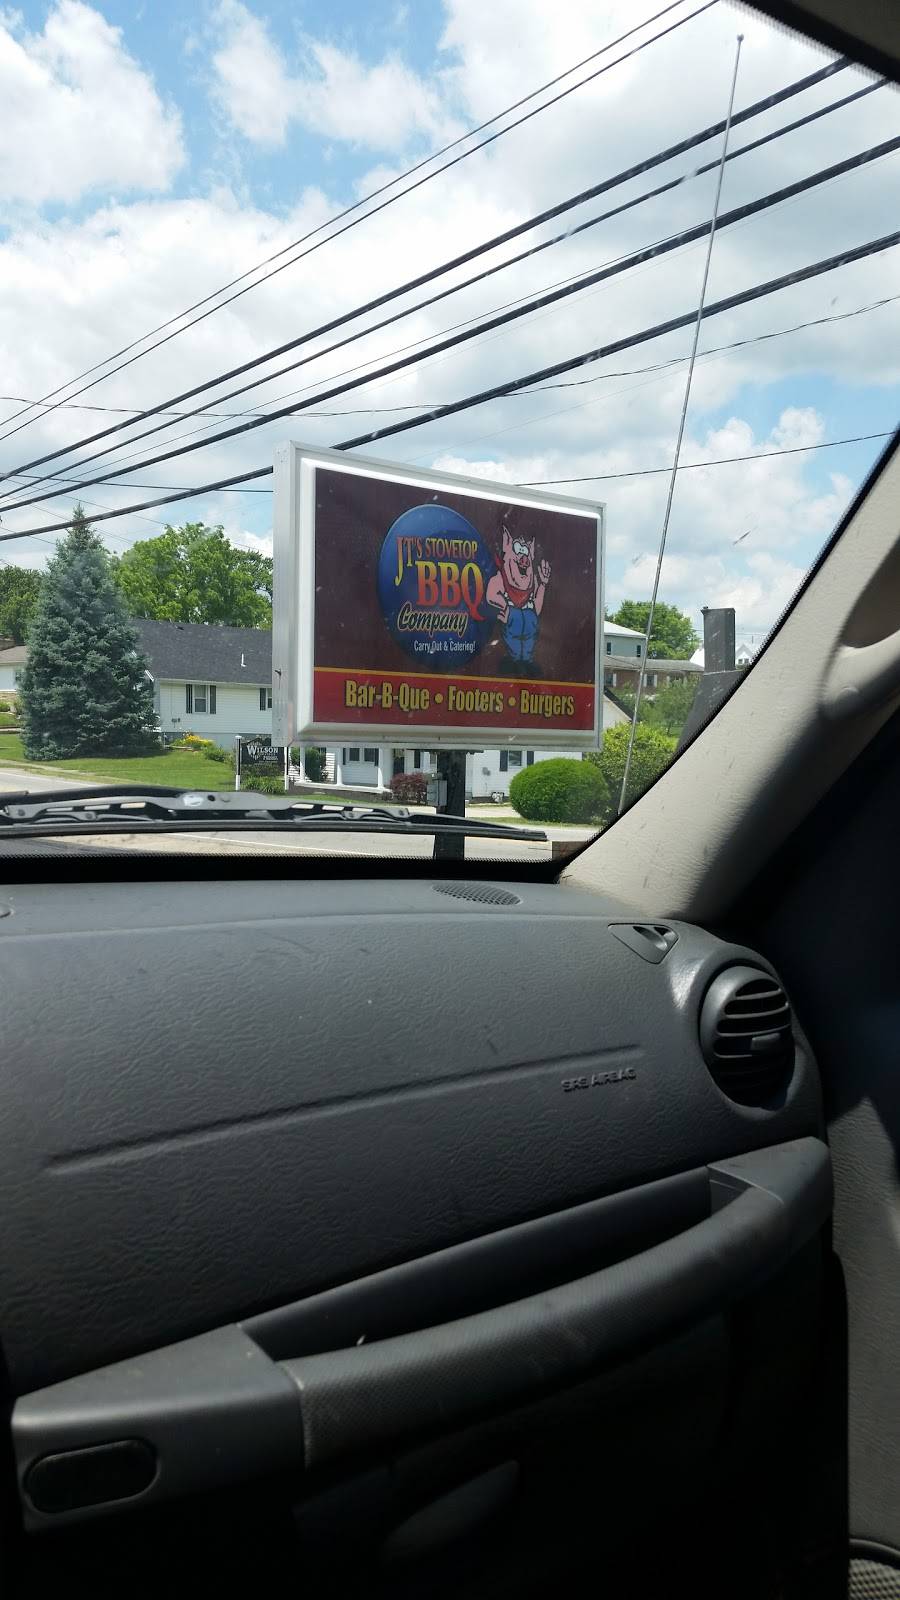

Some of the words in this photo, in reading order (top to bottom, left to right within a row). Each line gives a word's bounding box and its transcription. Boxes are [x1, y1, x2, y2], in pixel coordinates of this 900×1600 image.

[395, 537, 422, 586] JT'S
[425, 537, 478, 560] STOVETOP
[415, 560, 486, 621] BBQ
[397, 601, 469, 638] Company
[413, 640, 430, 653] Carry
[431, 641, 442, 651] Out
[443, 641, 448, 651] &
[450, 641, 476, 653] Catering!
[345, 680, 430, 712] Bar-B-Que
[447, 686, 504, 713] Footers
[520, 689, 575, 718] Burgers
